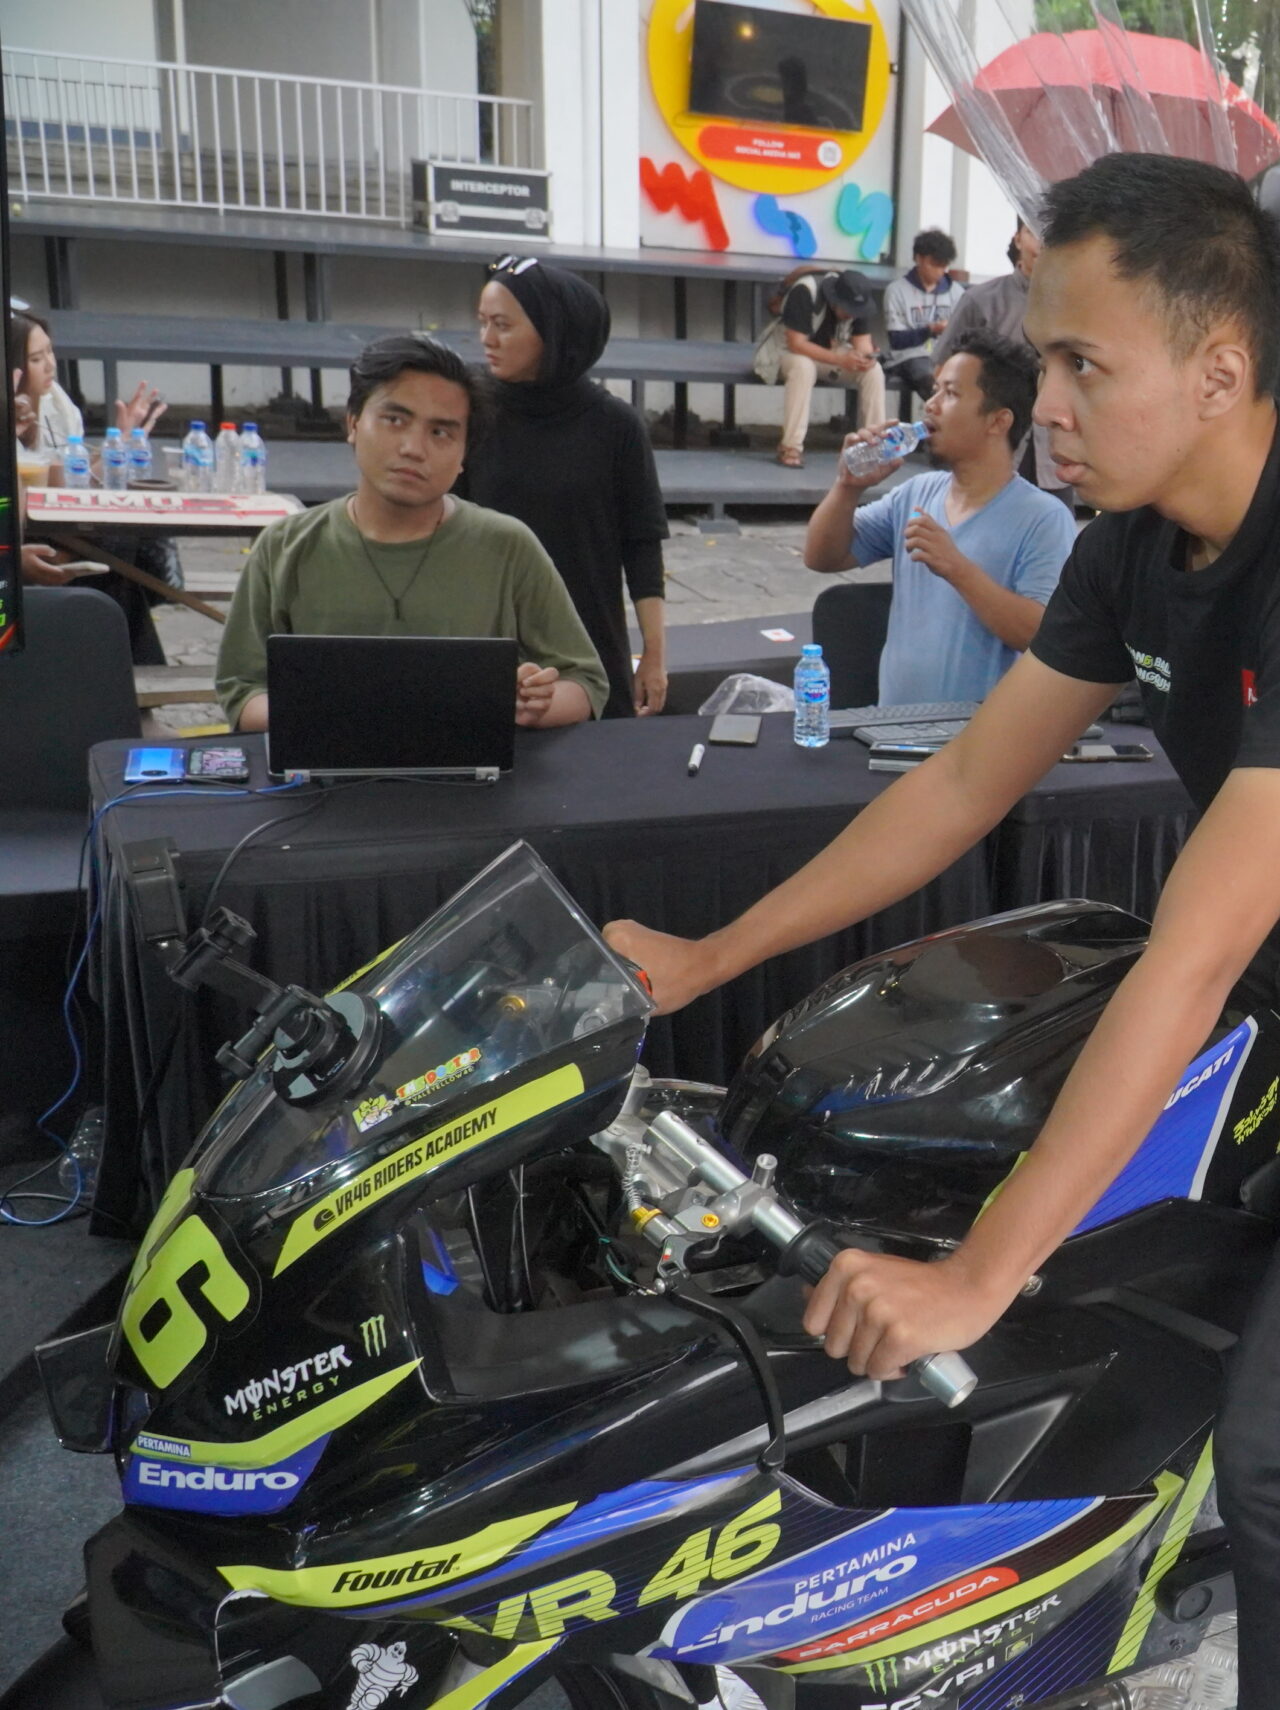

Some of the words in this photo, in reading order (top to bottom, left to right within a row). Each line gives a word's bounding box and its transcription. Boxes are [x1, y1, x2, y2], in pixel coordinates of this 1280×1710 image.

[451, 179, 530, 197] INTERCEPTOR
[396, 1075, 426, 1099] THE
[425, 1047, 482, 1085] DOCTOR
[1163, 1045, 1235, 1111] UCATI
[335, 1178, 371, 1217] VR46
[374, 1147, 422, 1191] RIDERS
[425, 1107, 497, 1160] ACADEMY
[224, 1344, 352, 1416] MONSTER
[252, 1375, 339, 1421] ENERGY
[137, 1436, 190, 1457] PERTAMINA
[139, 1462, 299, 1491] Enduro
[637, 1488, 782, 1607] 46
[794, 1532, 917, 1595] PERTAMINA
[331, 1553, 461, 1593] Fourtal
[810, 1600, 855, 1624] RACING
[857, 1586, 888, 1604] TEAM
